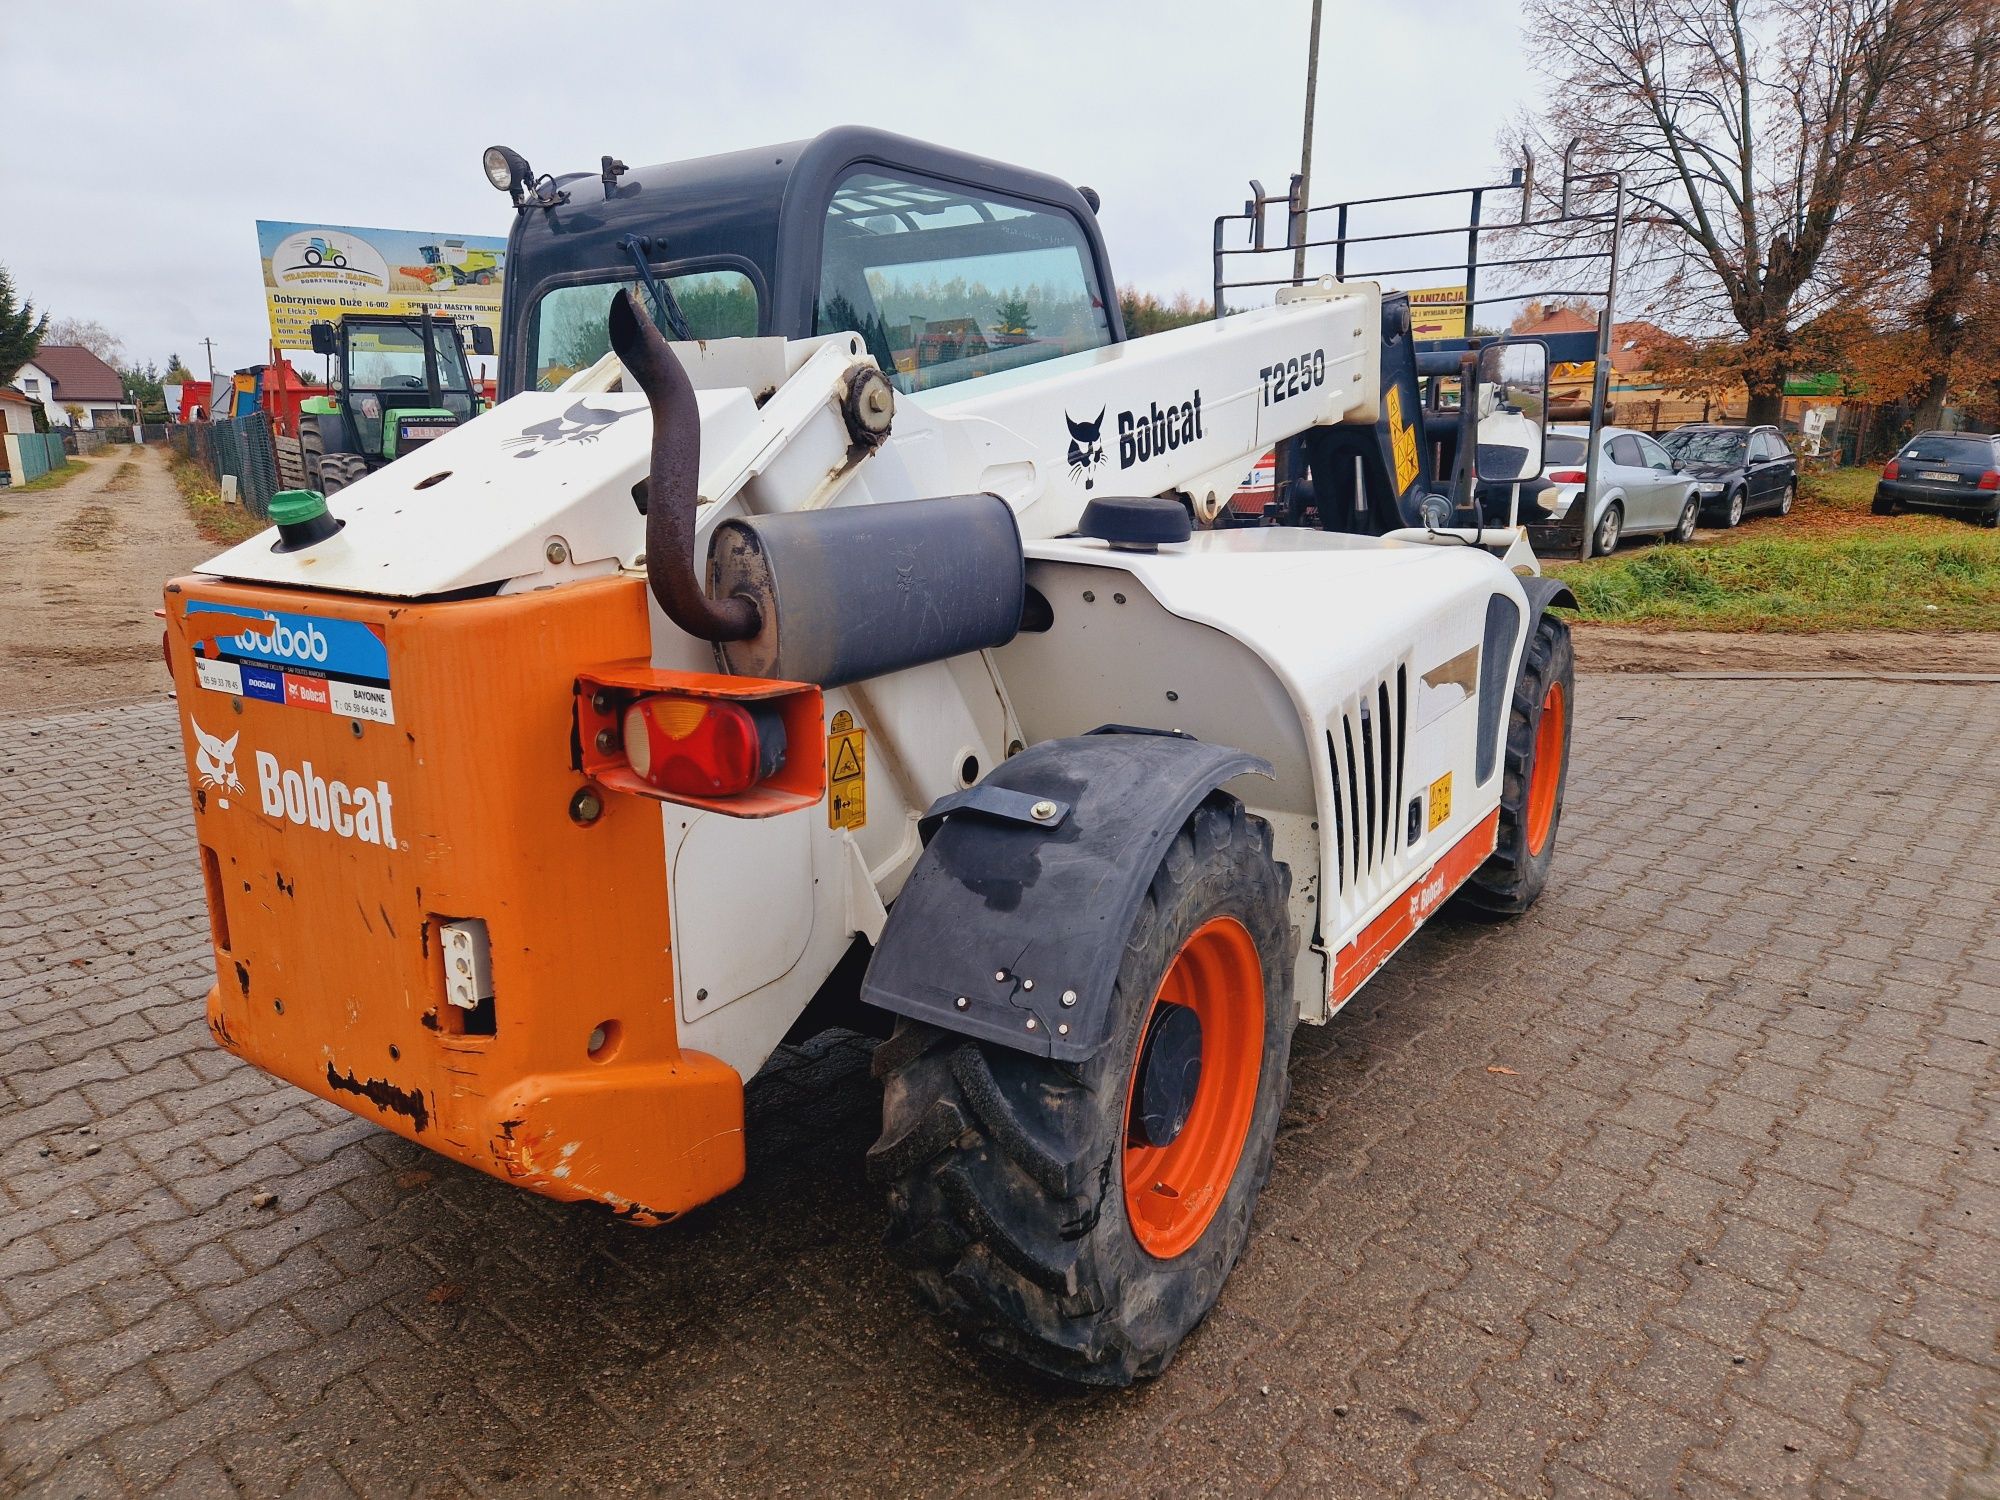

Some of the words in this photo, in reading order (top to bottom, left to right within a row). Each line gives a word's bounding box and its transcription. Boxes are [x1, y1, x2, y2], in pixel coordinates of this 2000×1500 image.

[274, 294, 336, 306] Dobrzyniewo
[340, 297, 362, 307] Duże
[1259, 348, 1325, 408] T2250
[1118, 388, 1203, 470] Bobcat
[248, 679, 276, 690] DOOSAN
[300, 686, 327, 704] Bobcat
[353, 689, 386, 703] BAYONNE
[344, 702, 352, 711] 05
[361, 705, 369, 714] 64
[379, 708, 387, 717] 24
[256, 750, 397, 850] Bobcat
